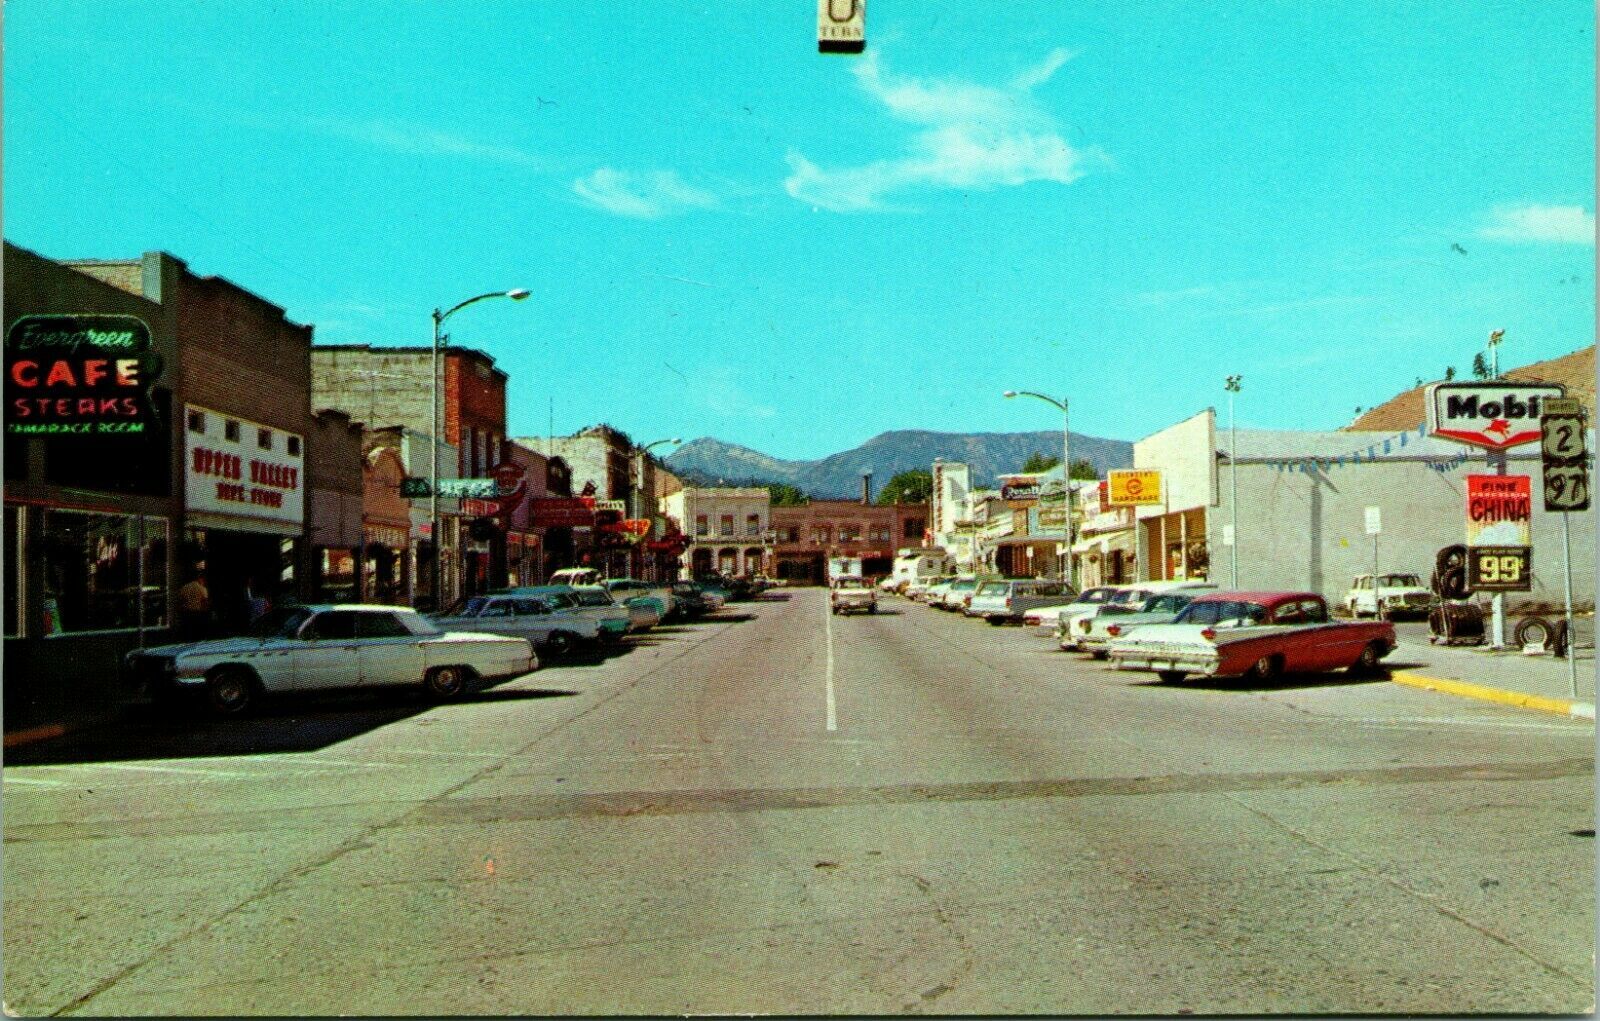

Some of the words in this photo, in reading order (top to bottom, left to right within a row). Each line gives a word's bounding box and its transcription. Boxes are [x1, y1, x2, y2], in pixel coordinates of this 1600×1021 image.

[19, 323, 134, 354] Evergreen
[11, 359, 140, 388] CAFE
[14, 398, 138, 417] STEAKS
[1447, 394, 1549, 419] Mobi
[1556, 425, 1573, 452] 2
[193, 446, 242, 481] UPPER
[250, 459, 298, 490] VALLEY
[1550, 474, 1583, 502] 97
[1470, 499, 1530, 521] CHINA
